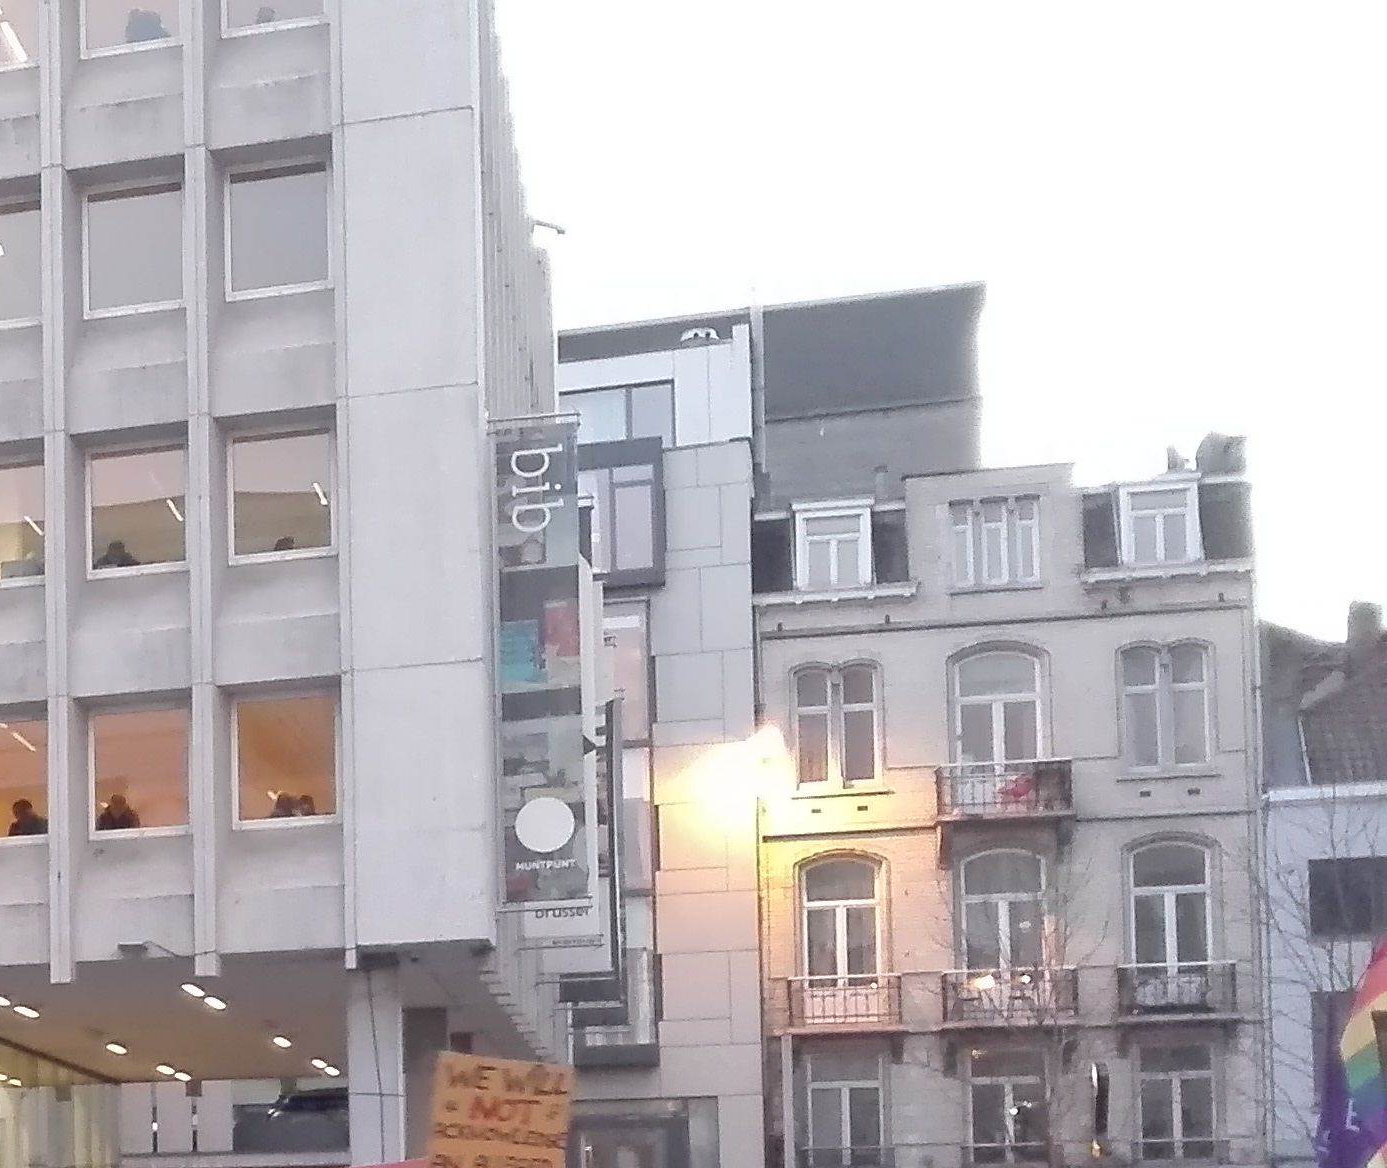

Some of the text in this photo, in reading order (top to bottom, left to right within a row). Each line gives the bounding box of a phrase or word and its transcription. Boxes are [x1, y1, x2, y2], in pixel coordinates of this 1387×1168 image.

[511, 443, 564, 532] bib
[446, 1063, 498, 1091] WE
[469, 1096, 542, 1125] NOT
